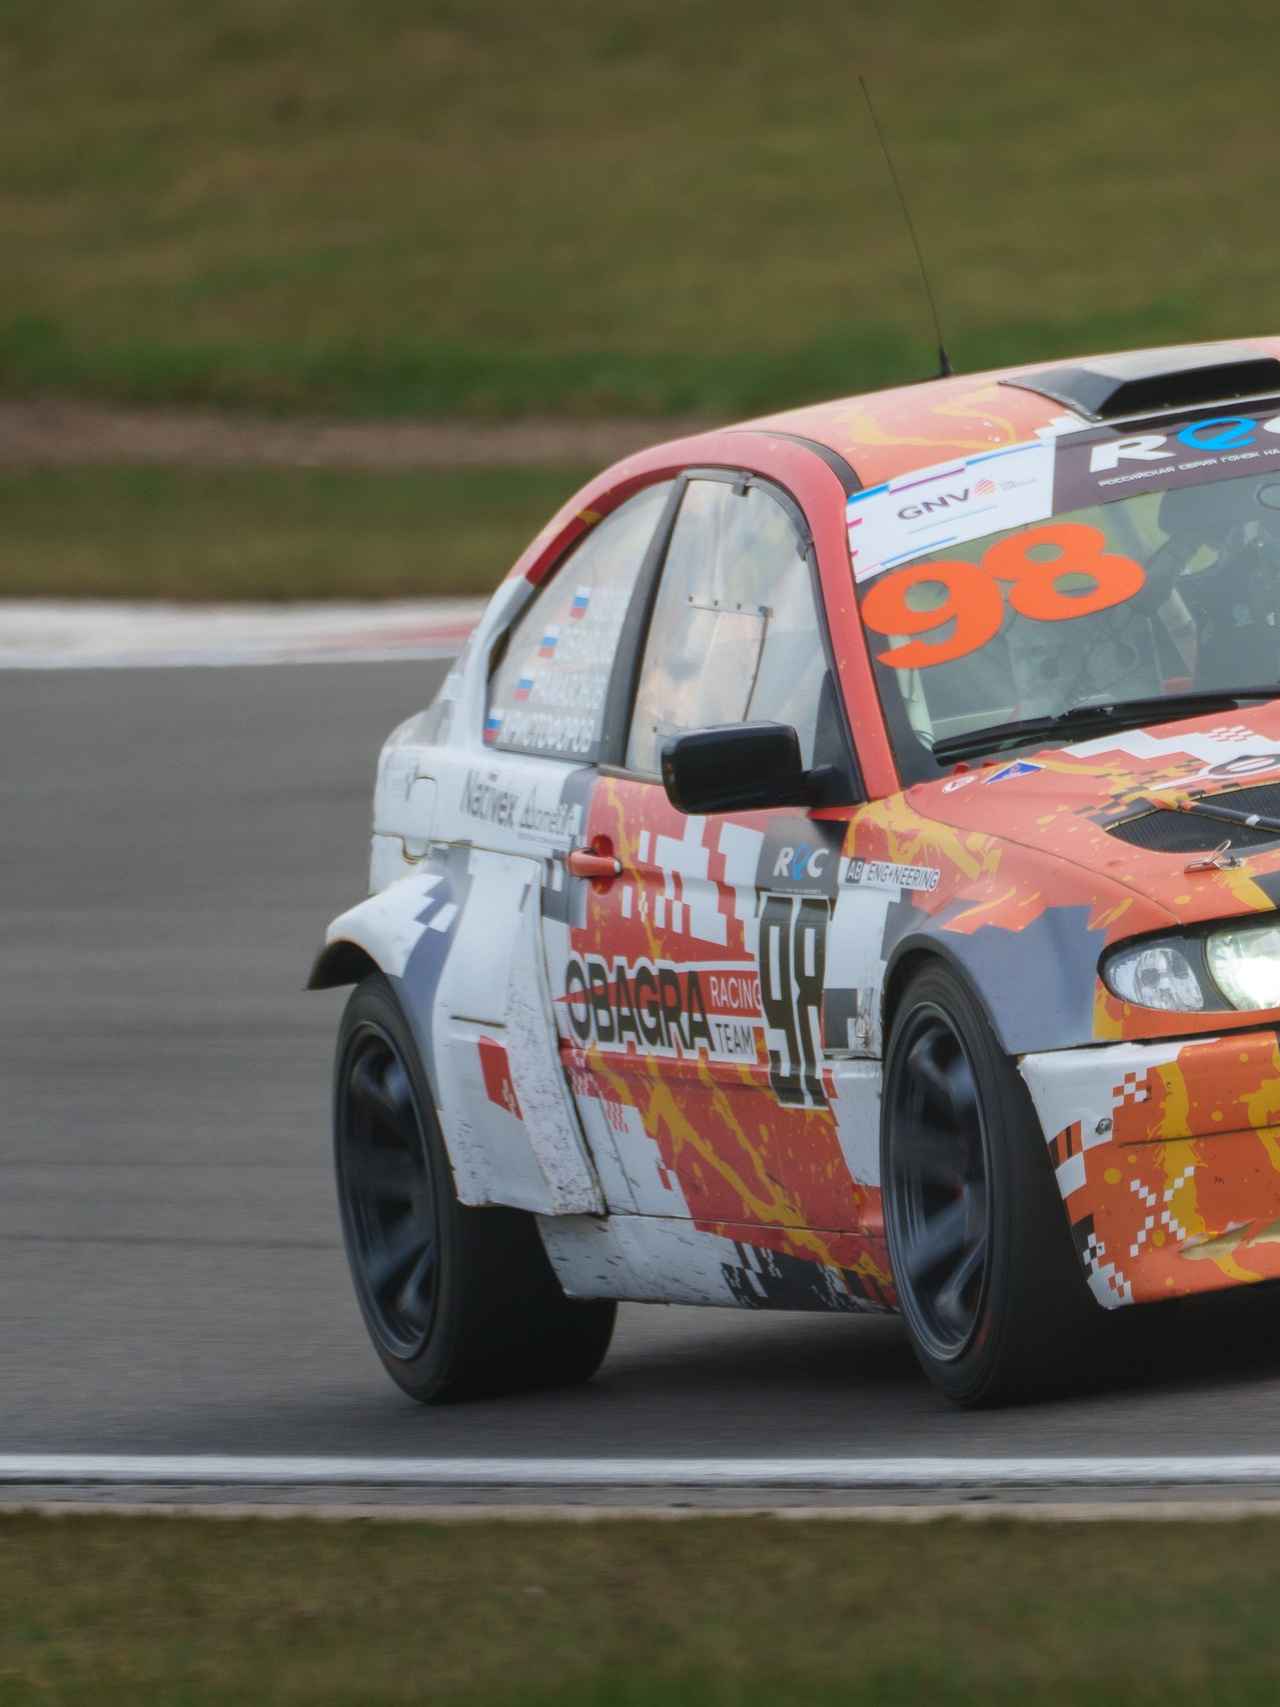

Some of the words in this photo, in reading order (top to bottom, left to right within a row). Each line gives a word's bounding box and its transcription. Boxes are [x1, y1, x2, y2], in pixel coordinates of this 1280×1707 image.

[1099, 466, 1176, 486] РОССИЙСКАЯ
[1179, 459, 1217, 470] СЕРИЯ
[1221, 452, 1260, 465] ГОНОК
[1264, 447, 1280, 456] НА
[897, 488, 970, 520] GNV
[861, 523, 1146, 669] 98
[847, 860, 864, 881] AB
[566, 959, 715, 1052] OBAGRA
[710, 976, 762, 1010] RACING
[759, 896, 829, 1108] 98
[715, 1022, 756, 1055] TEAM
